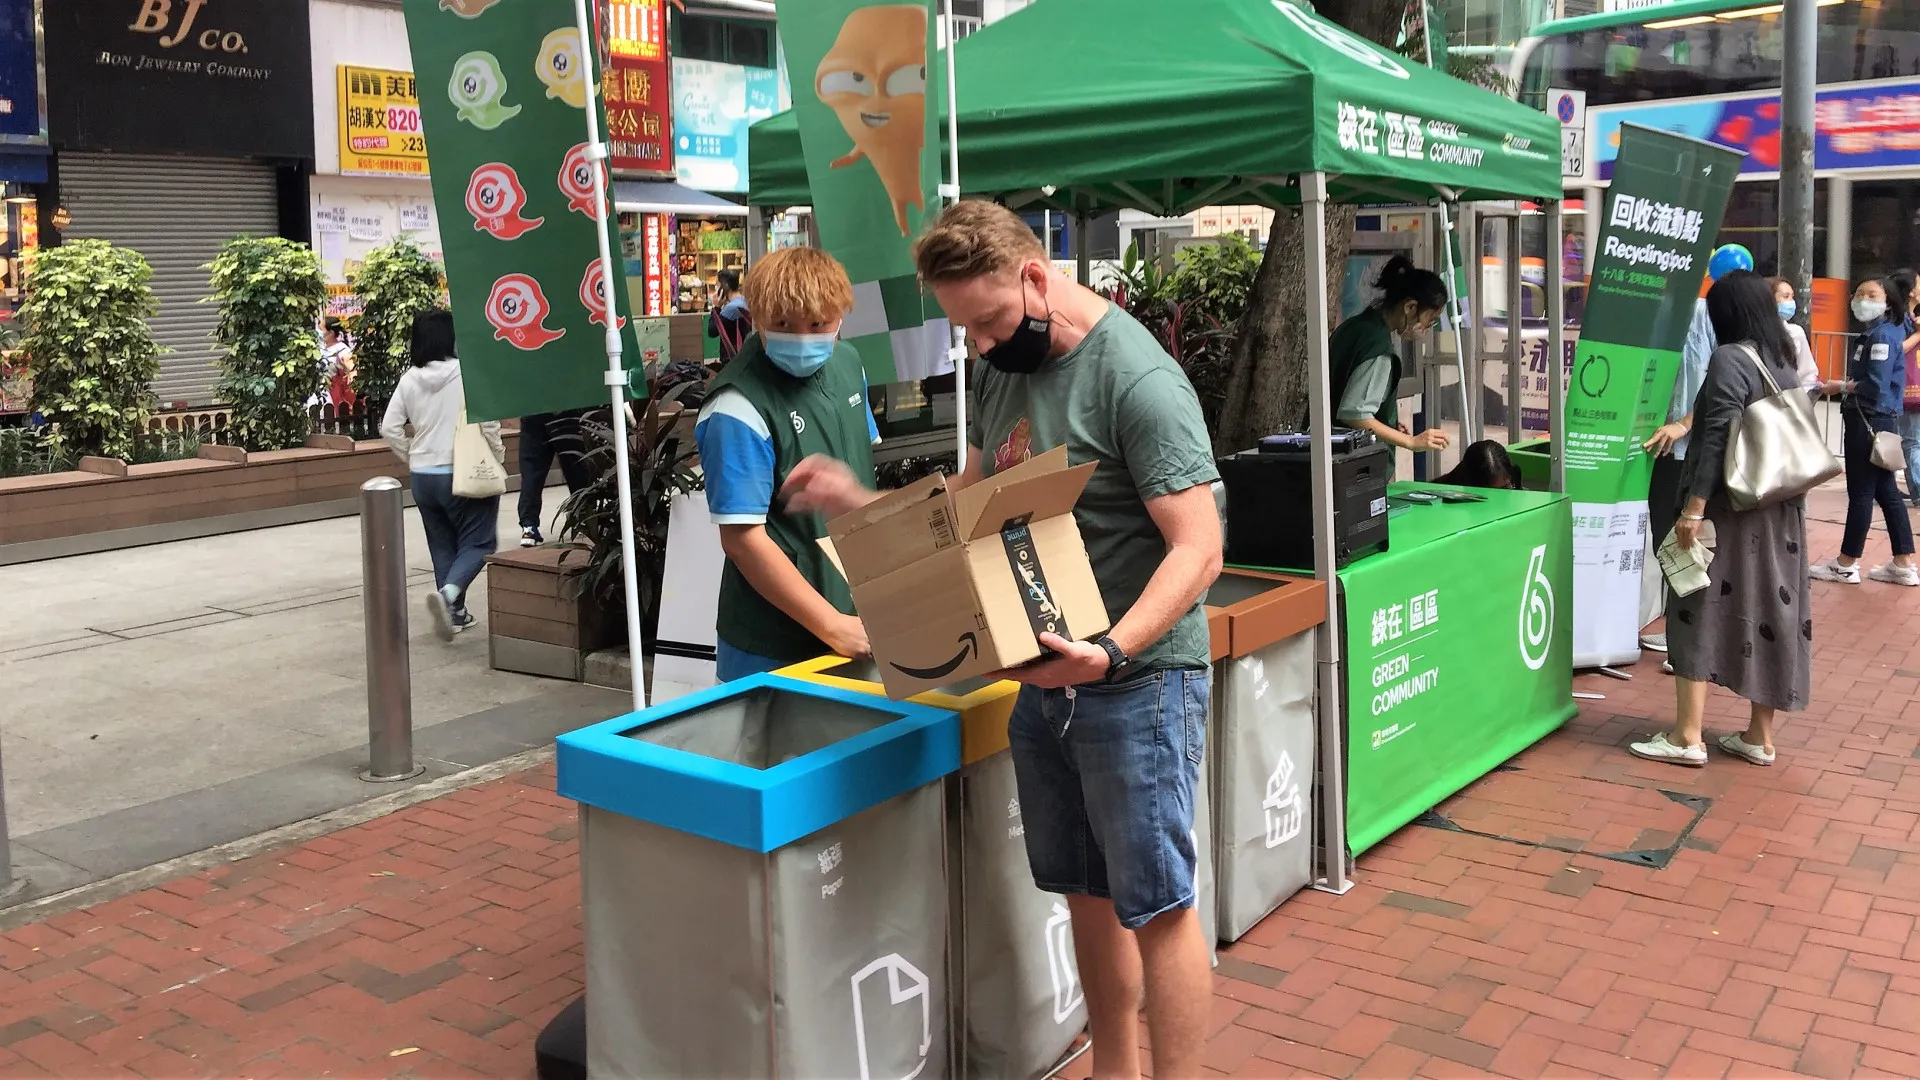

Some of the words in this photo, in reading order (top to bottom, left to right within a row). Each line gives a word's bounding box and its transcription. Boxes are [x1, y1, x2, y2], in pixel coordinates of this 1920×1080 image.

[349, 106, 387, 129] 胡漢文
[1427, 119, 1460, 140] GREEN
[1384, 111, 1425, 160] 區區
[1429, 142, 1485, 168] COMMUNITY
[1569, 158, 1581, 173] 12
[1610, 193, 1704, 244] 回收流動點
[1007, 527, 1028, 542] prime
[1371, 603, 1403, 647] 綠在
[1409, 588, 1439, 632] 區區
[1372, 652, 1410, 688] GREEN
[1371, 667, 1439, 716] COMMUNITY
[821, 876, 844, 899] Paper
